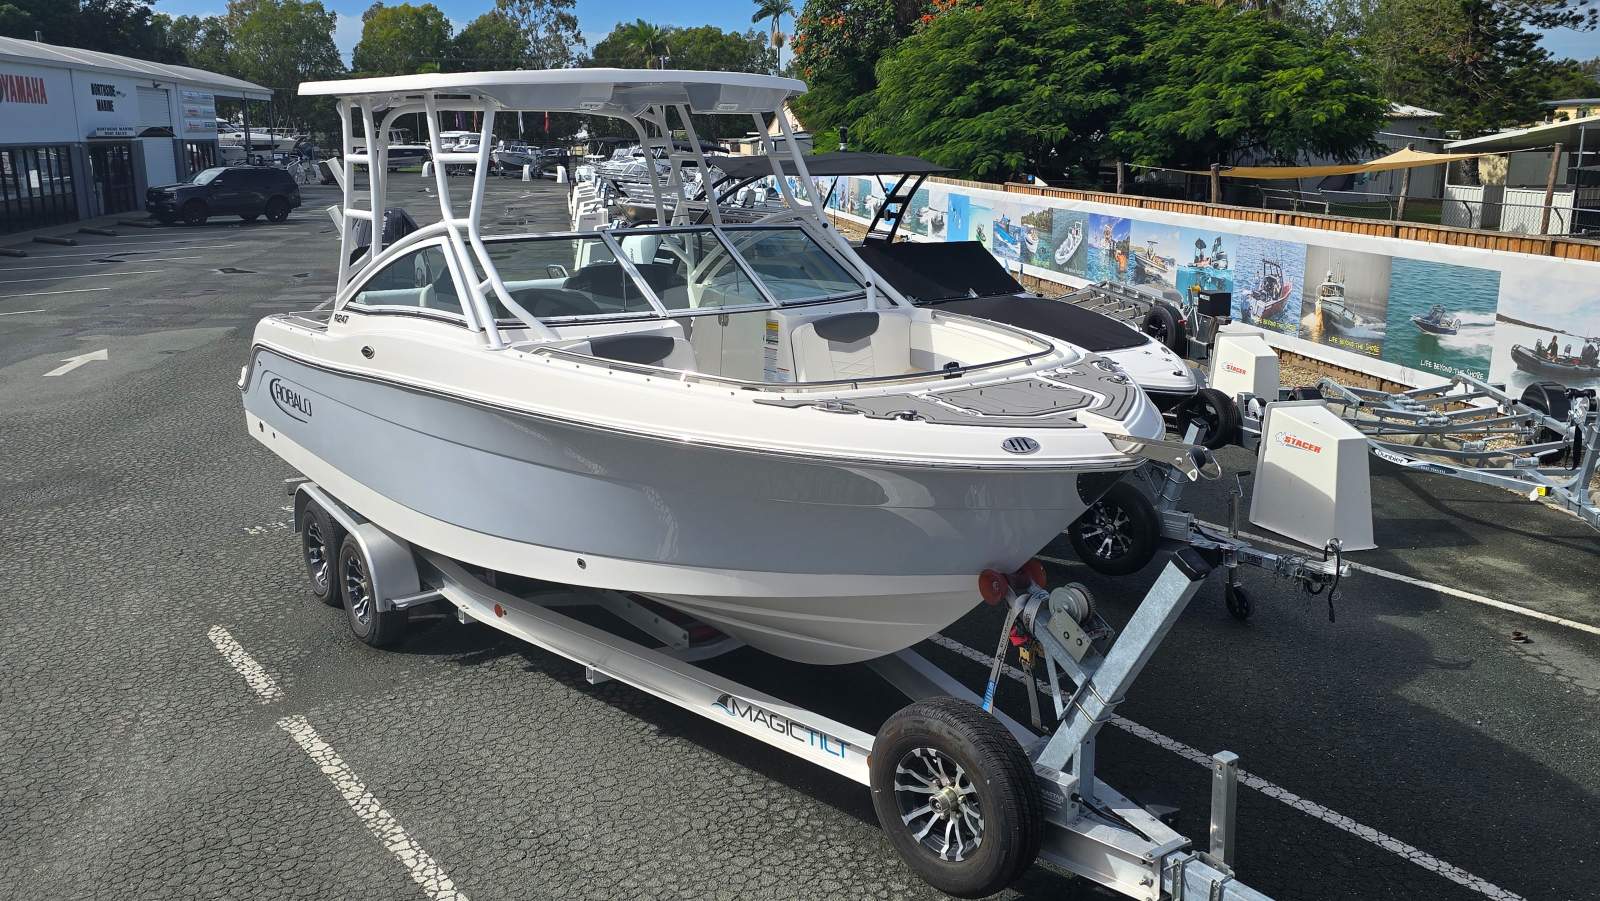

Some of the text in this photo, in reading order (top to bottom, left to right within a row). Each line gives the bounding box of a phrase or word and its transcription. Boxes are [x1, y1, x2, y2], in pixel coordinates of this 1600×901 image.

[1, 73, 48, 105] YAMAHA
[96, 99, 115, 112] MARINE
[1329, 336, 1338, 345] LIFE
[1226, 364, 1247, 376] STACER
[1420, 359, 1432, 368] LIFE
[1433, 362, 1452, 373] BEYOND
[1467, 368, 1484, 380] SHORE
[275, 383, 312, 417] ROBALO
[1284, 434, 1322, 454] STACER
[732, 698, 850, 759] MAGICTILT
